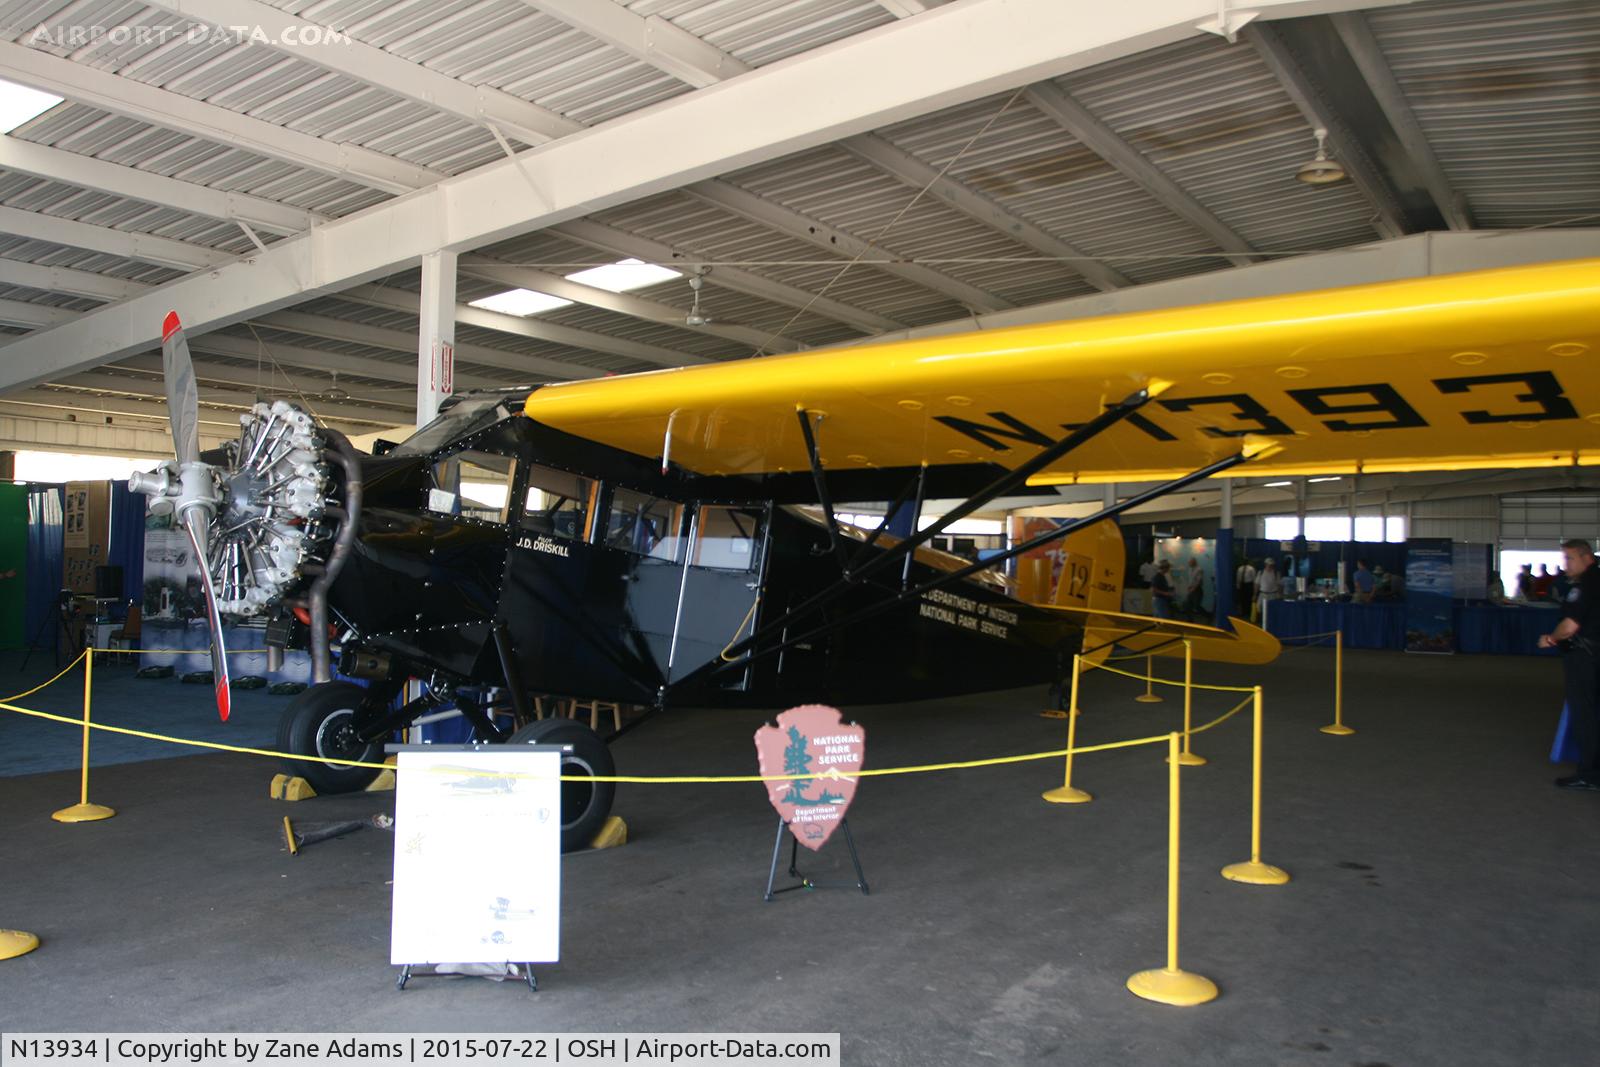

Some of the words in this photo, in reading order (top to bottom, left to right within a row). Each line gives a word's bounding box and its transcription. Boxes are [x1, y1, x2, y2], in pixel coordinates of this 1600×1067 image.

[516, 537, 532, 549] J.D.
[533, 541, 569, 557] DRISKILL
[928, 589, 977, 612] DEPARTMENT
[977, 603, 988, 615] OF
[989, 606, 1018, 625] INTERIOR
[920, 603, 956, 625] NATIONAL
[958, 613, 978, 631] PARK
[980, 620, 1008, 639] SERVICE
[813, 735, 860, 745] NATIONAL
[825, 745, 850, 754] PARK
[818, 754, 858, 764] SERVICE
[795, 806, 836, 816] Department
[792, 815, 800, 823] of
[813, 812, 840, 821] Interior
